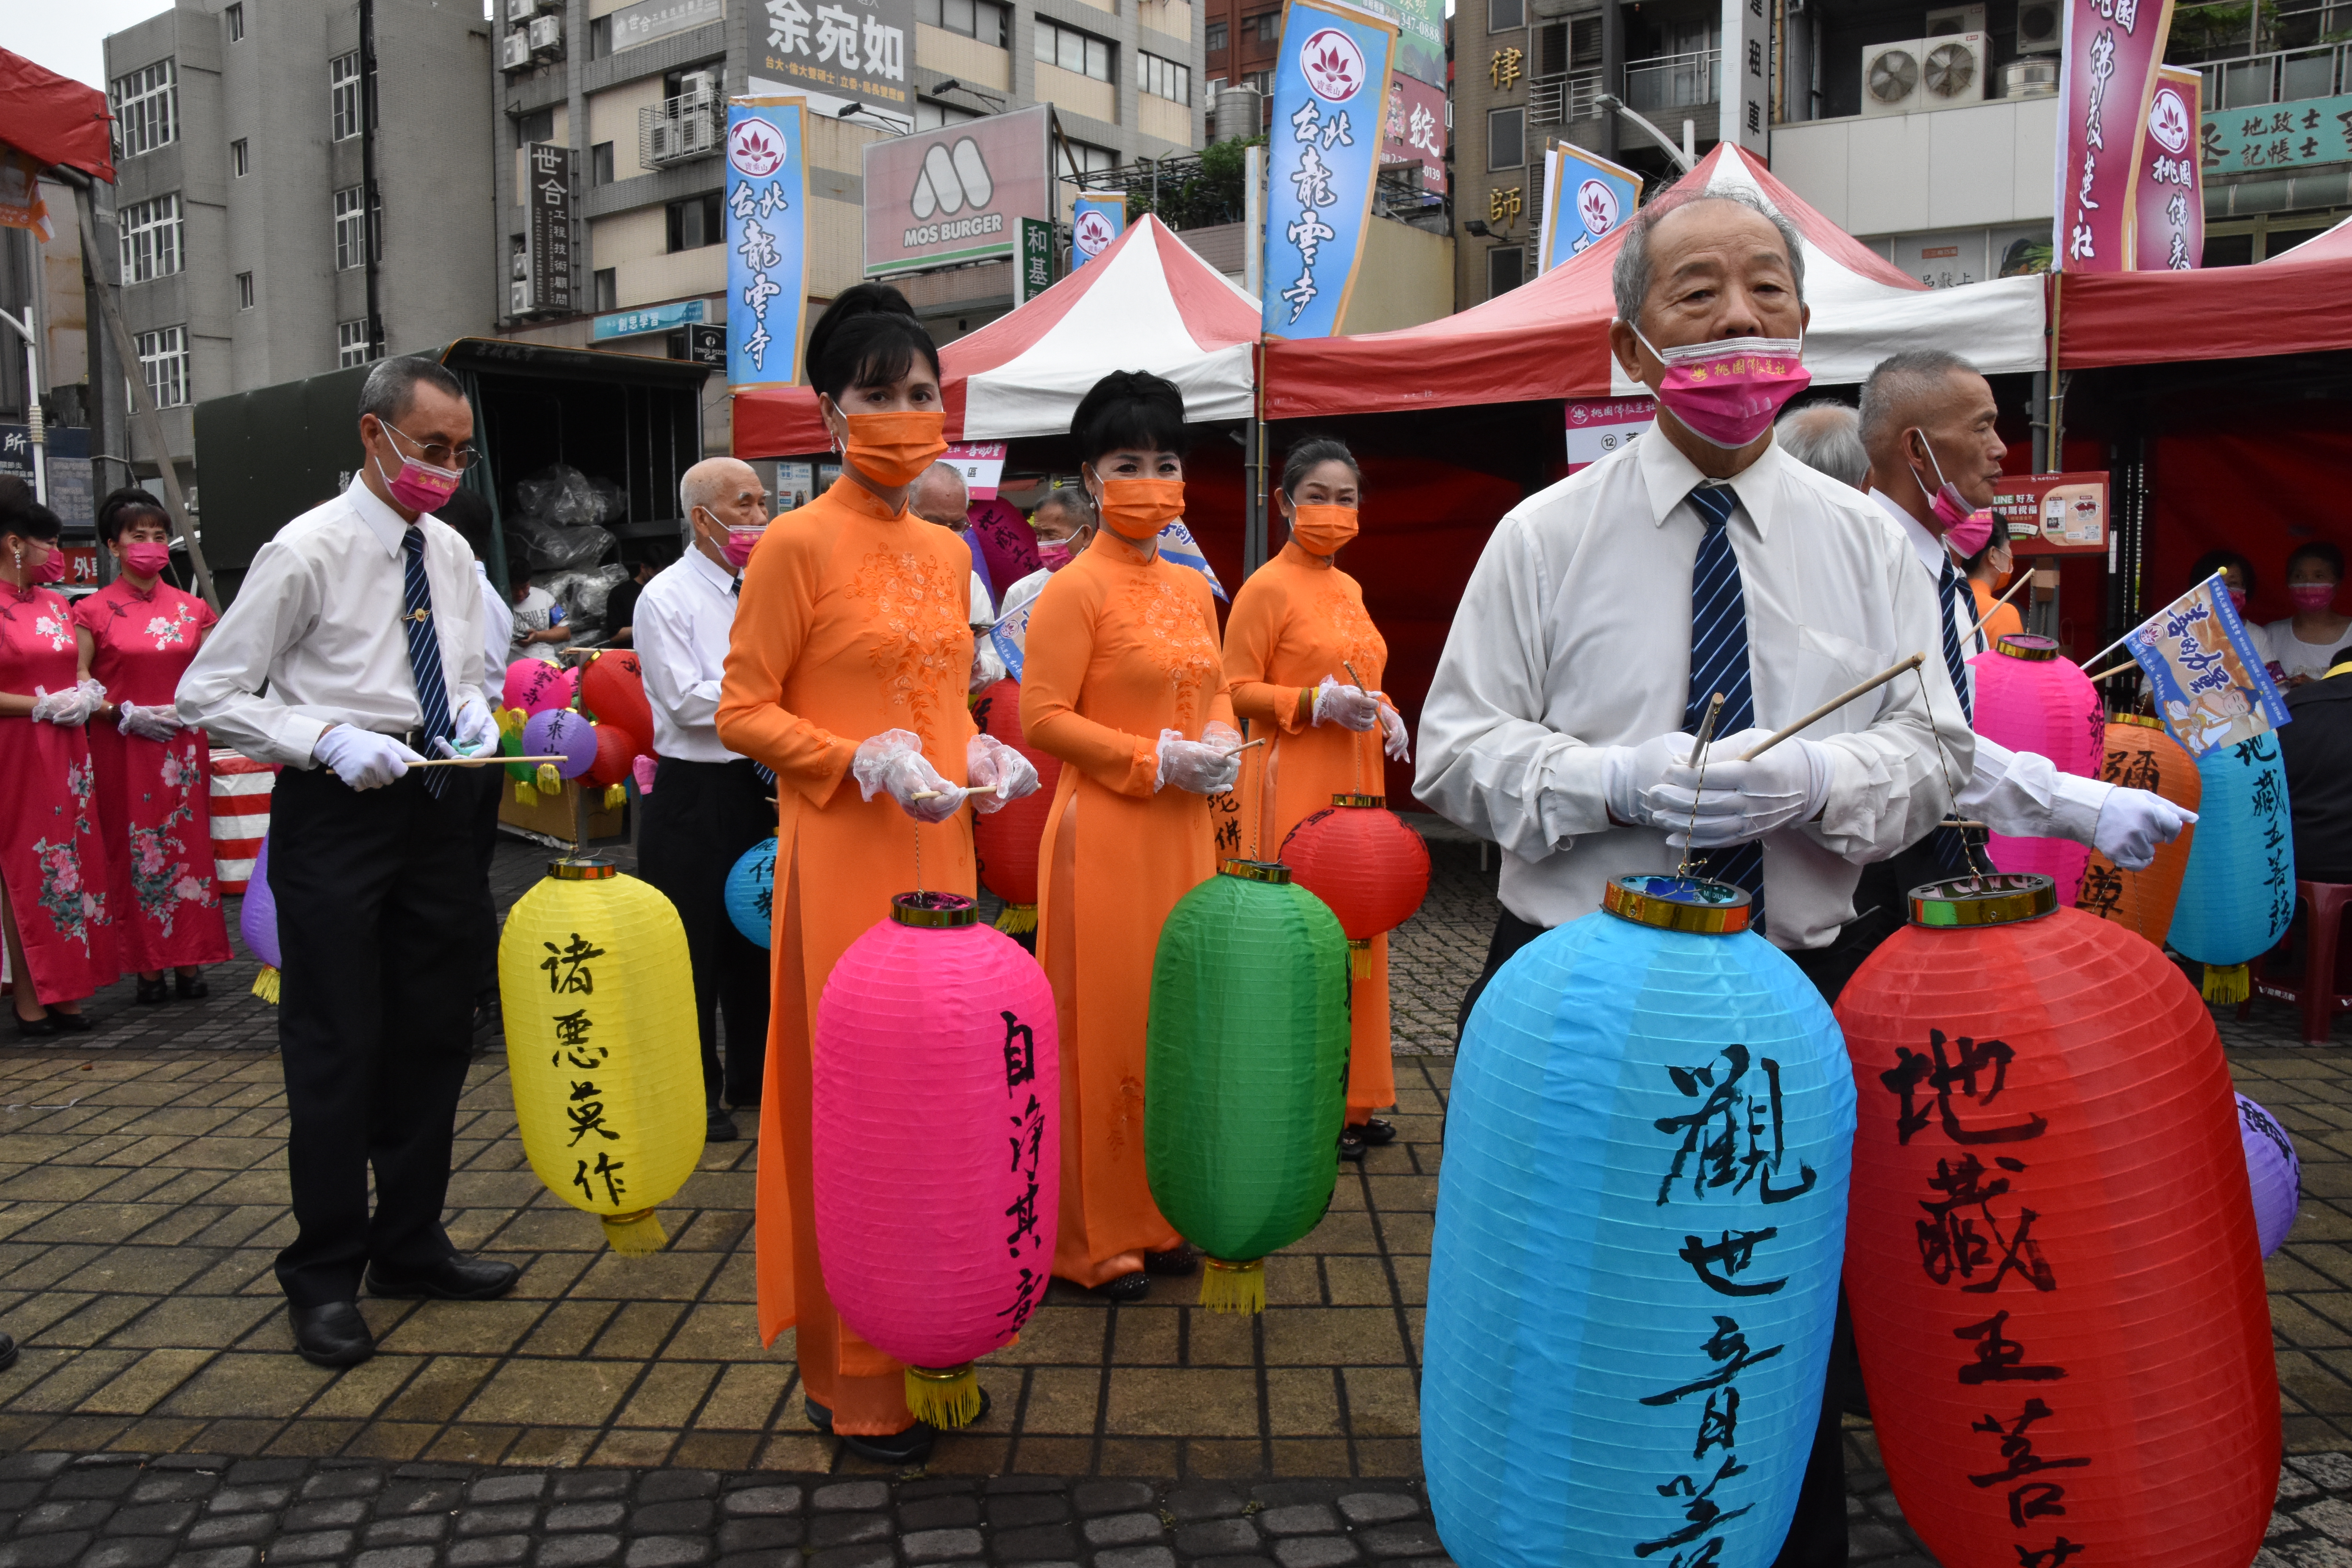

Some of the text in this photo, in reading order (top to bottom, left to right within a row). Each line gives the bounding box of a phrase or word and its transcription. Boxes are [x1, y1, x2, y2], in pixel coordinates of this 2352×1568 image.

[628, 13, 651, 33] 世合
[765, 0, 904, 82] 余宛如
[1401, 12, 1440, 43] 347-0888
[1490, 47, 1523, 229] 律師
[2241, 108, 2321, 137] 地政士
[2241, 136, 2319, 167] 記帳士
[532, 148, 568, 205] 世合
[903, 213, 1003, 248] MOS BURGER
[1283, 98, 1354, 326] 台北龍雲寺
[553, 210, 568, 305] 工程技術顧問
[729, 180, 788, 372] 台北龍雲寺
[1027, 225, 1048, 287] 和基
[2016, 494, 2035, 503] 好友
[2167, 603, 2230, 694] 善的力量
